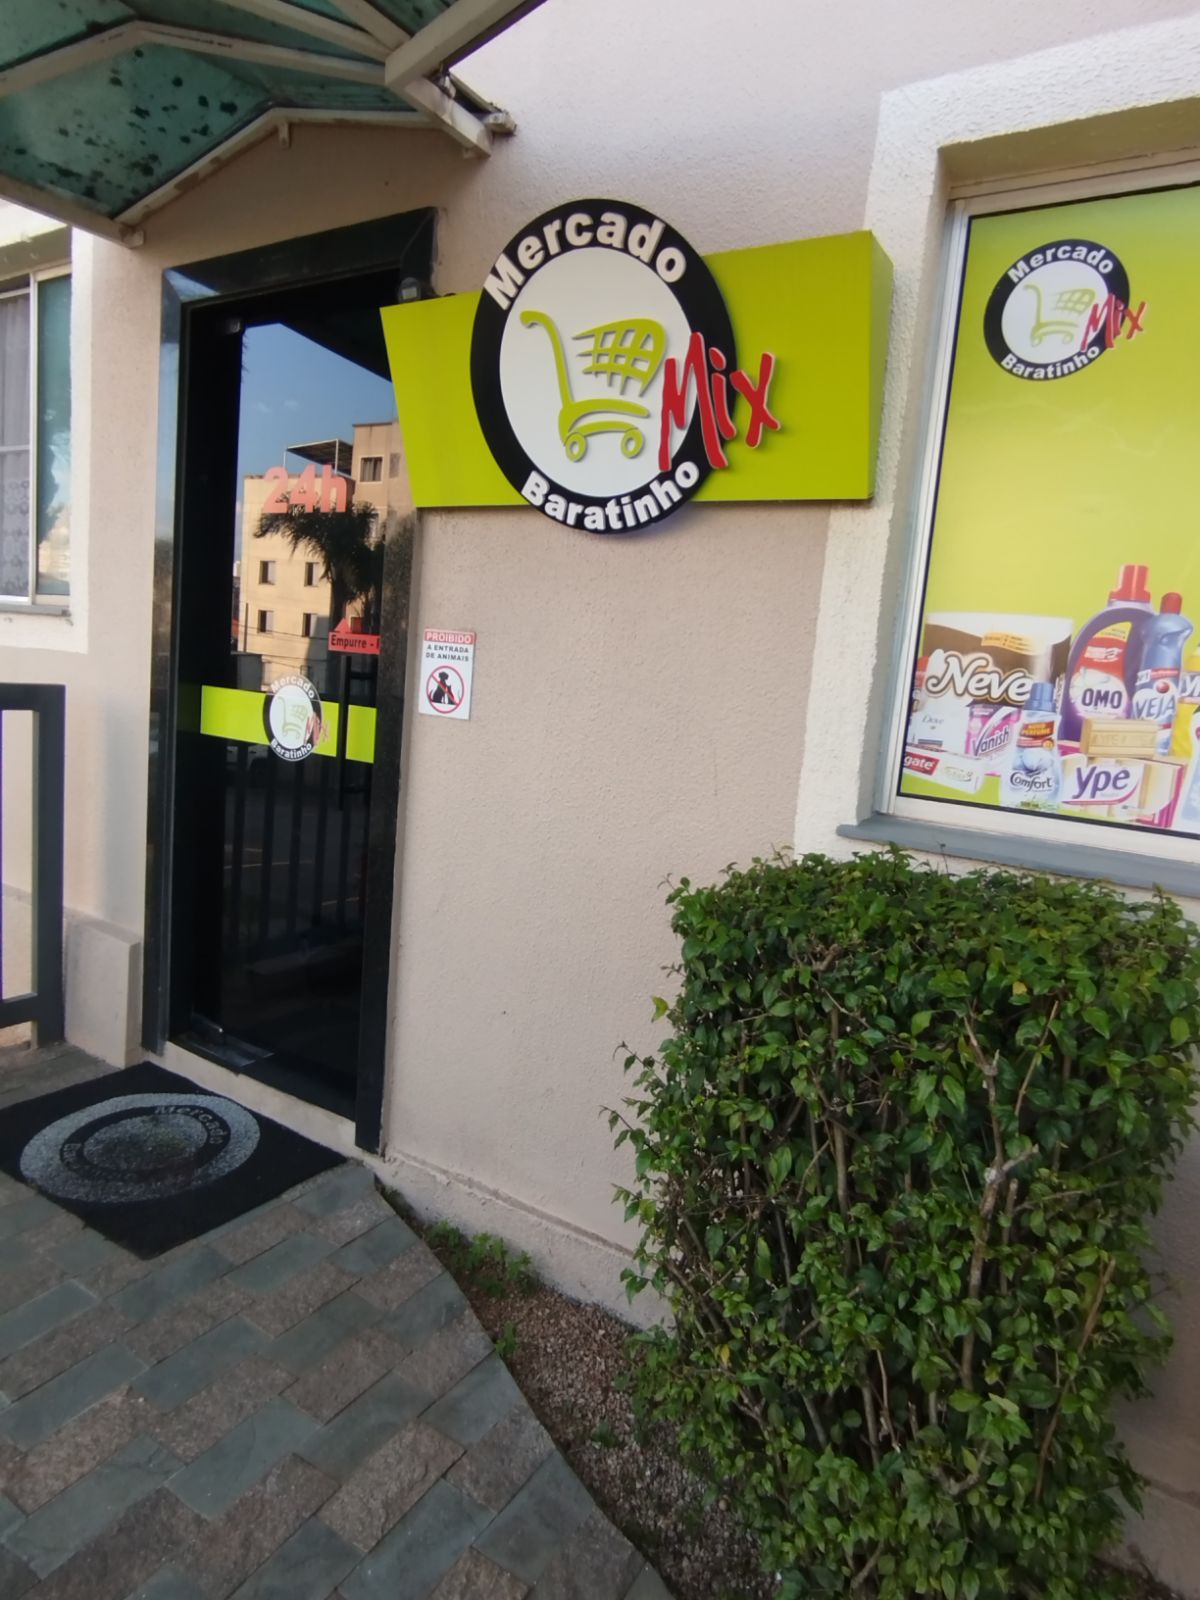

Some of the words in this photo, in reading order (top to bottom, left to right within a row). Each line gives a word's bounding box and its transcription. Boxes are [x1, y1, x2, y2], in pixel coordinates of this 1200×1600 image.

[483, 211, 687, 311] Mercado
[1007, 244, 1114, 283] Mercado
[1080, 292, 1147, 352] Mix
[1001, 345, 1101, 380] Baratinho
[658, 331, 781, 472] Mix
[263, 463, 348, 514] 24h
[520, 461, 700, 531] Baratinho
[330, 634, 368, 650] Empurre
[426, 631, 473, 645] PROIBIDO
[434, 645, 469, 653] ENTRADA
[437, 653, 469, 662] ANIMAIS
[271, 675, 315, 699] Mercado
[925, 653, 1035, 702] Neve
[1081, 687, 1123, 710] OMO
[1135, 694, 1176, 720] VEJA
[271, 738, 313, 759] Baratinho
[972, 722, 1010, 757] Vanish
[1009, 771, 1053, 792] Comfort
